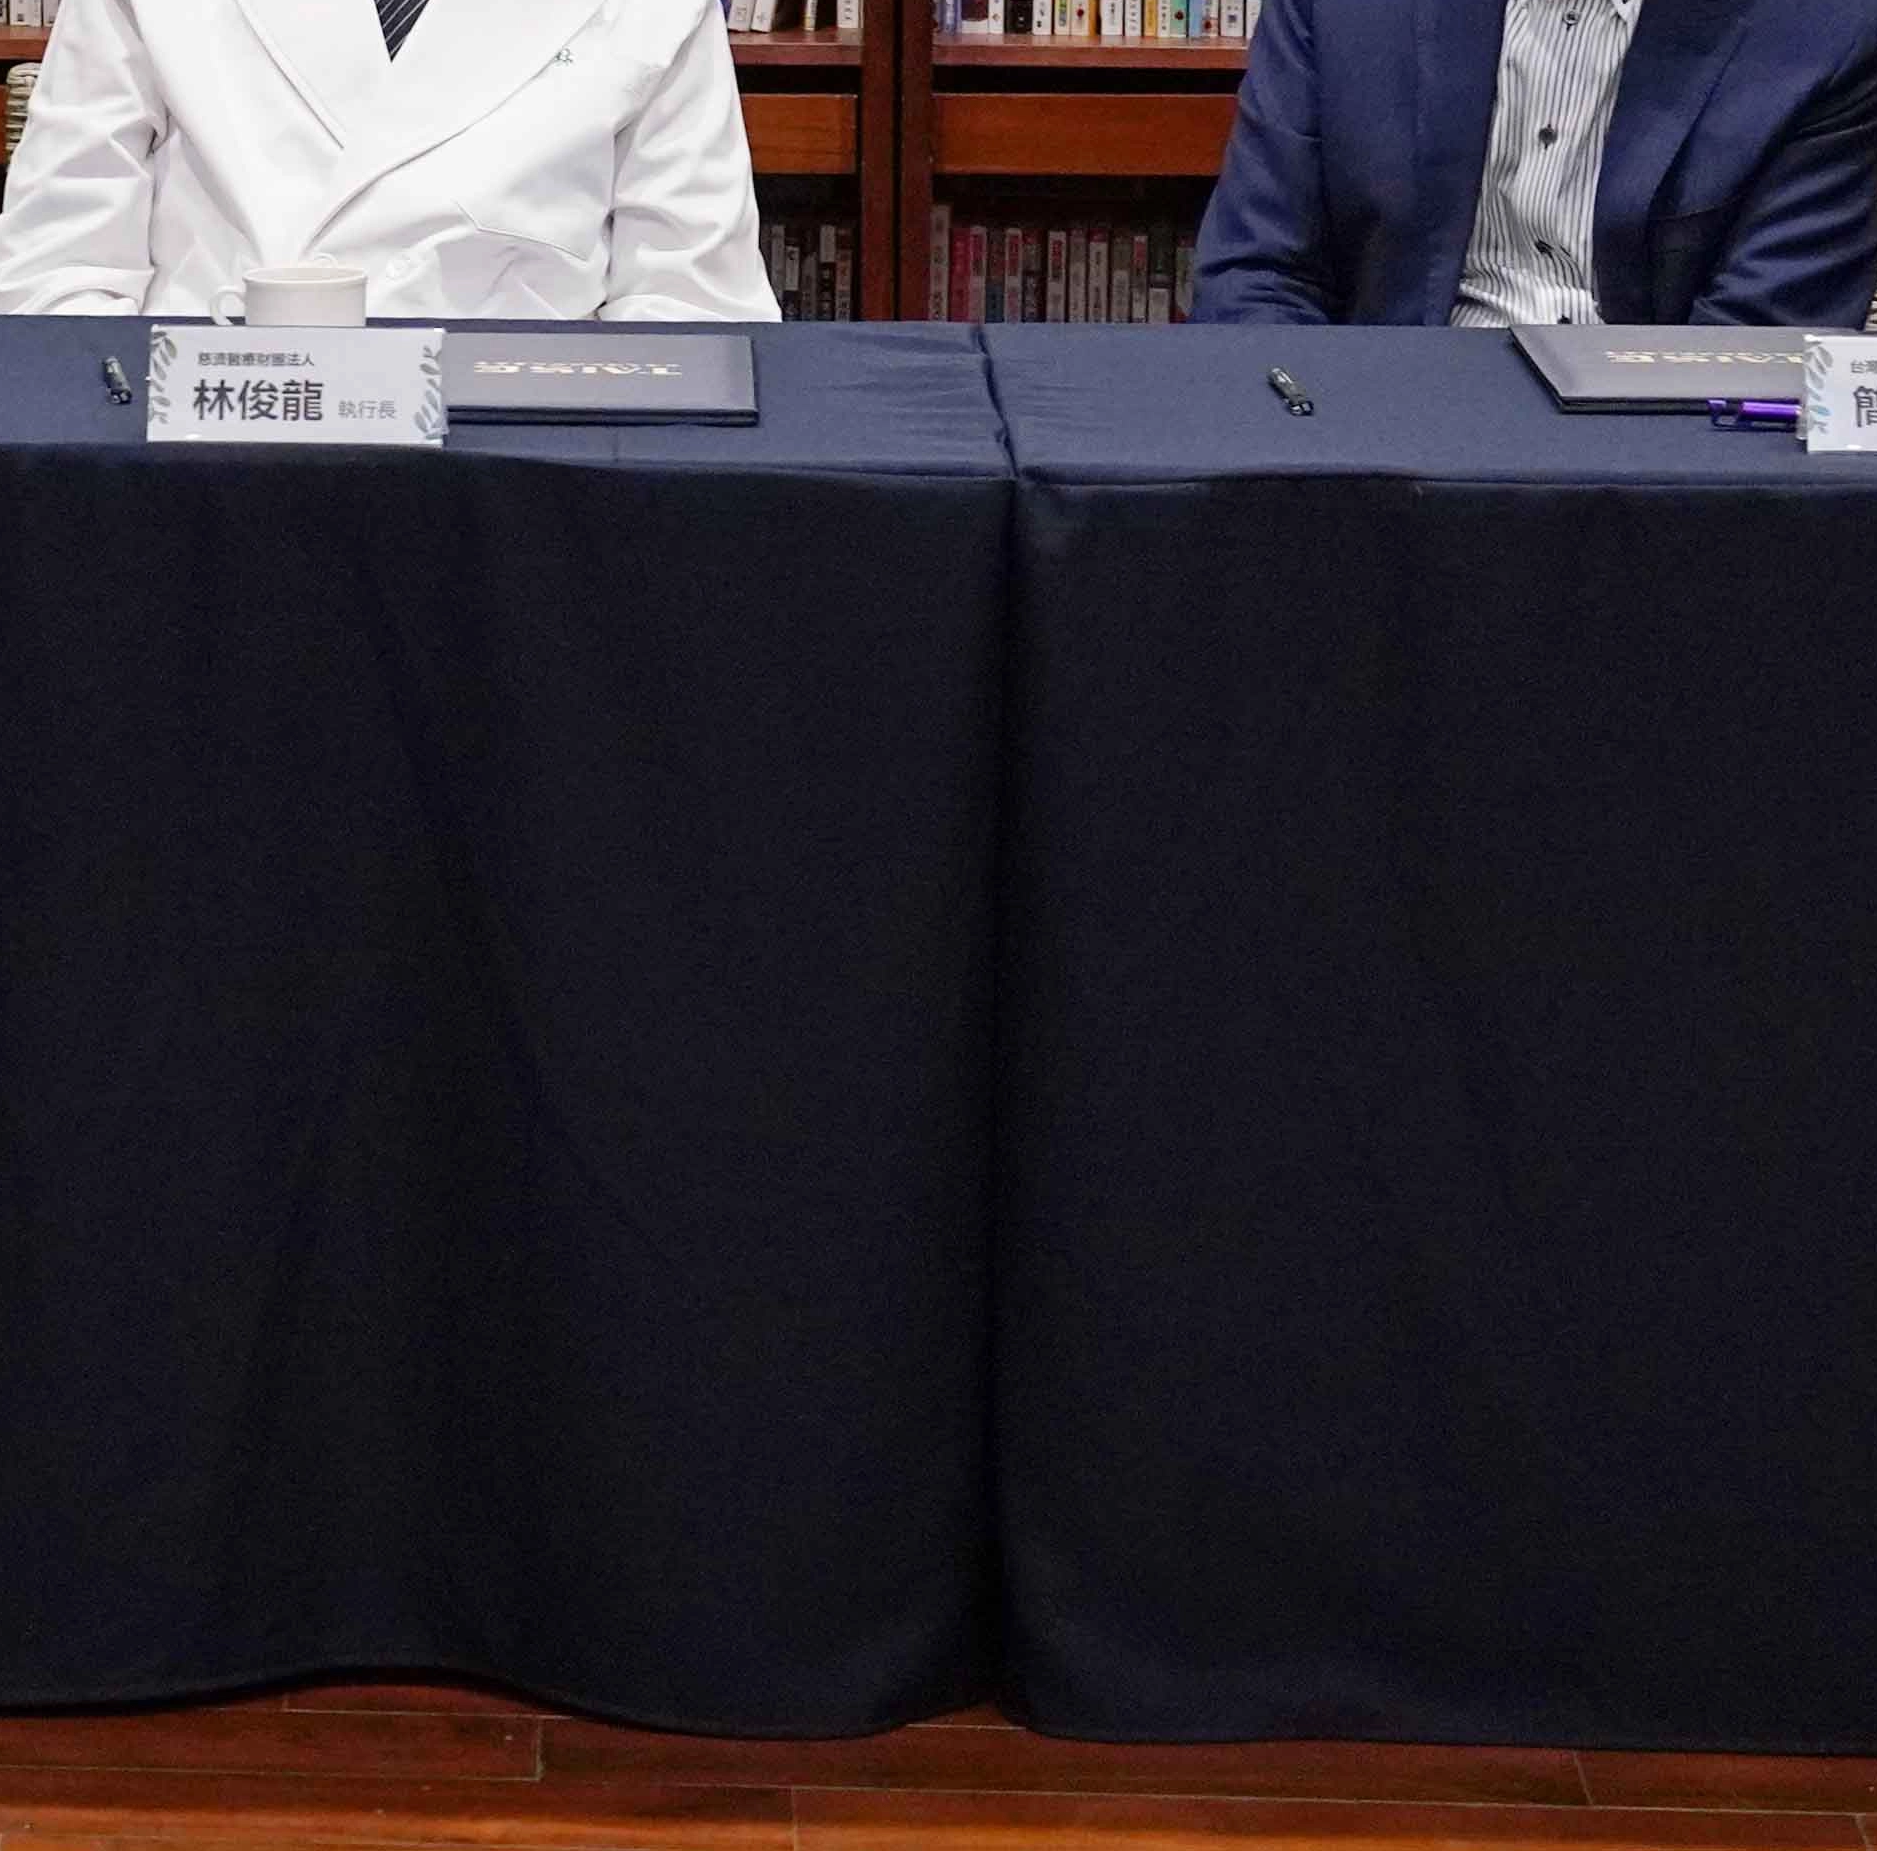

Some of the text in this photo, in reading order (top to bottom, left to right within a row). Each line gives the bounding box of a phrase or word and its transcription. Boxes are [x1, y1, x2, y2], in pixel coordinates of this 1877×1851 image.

[193, 379, 398, 421] 林俊龍 執行長
